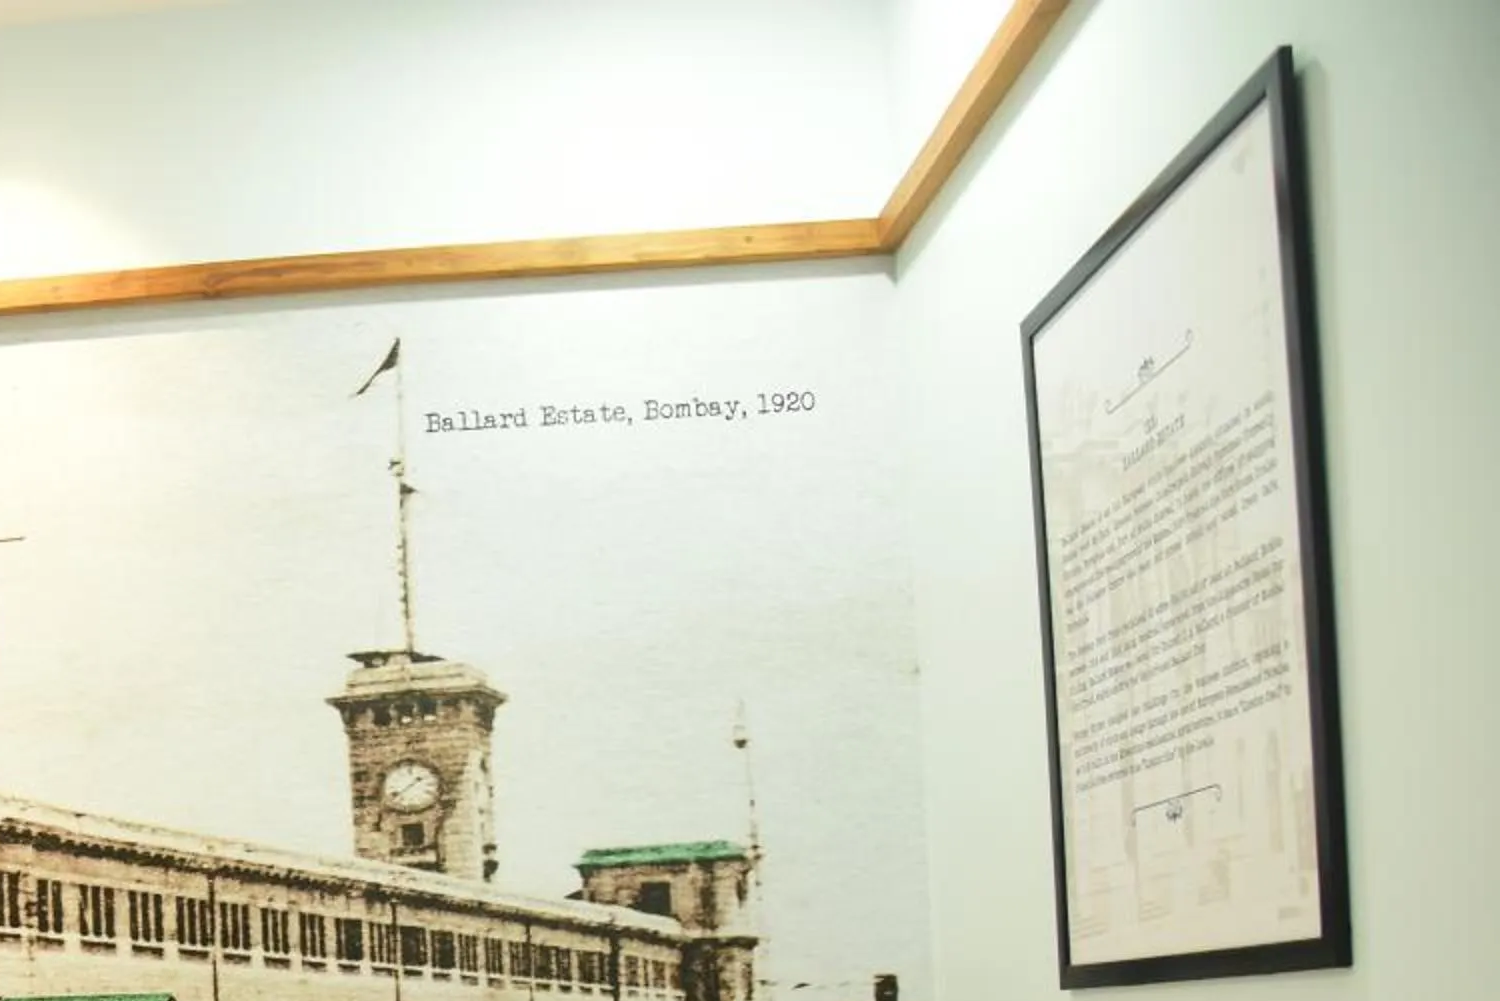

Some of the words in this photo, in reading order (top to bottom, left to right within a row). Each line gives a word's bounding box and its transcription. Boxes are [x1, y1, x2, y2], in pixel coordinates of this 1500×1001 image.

[425, 407, 529, 433] Ballard
[541, 405, 633, 426] Estate,
[643, 397, 748, 421] Bombay,
[757, 391, 816, 415] 1920
